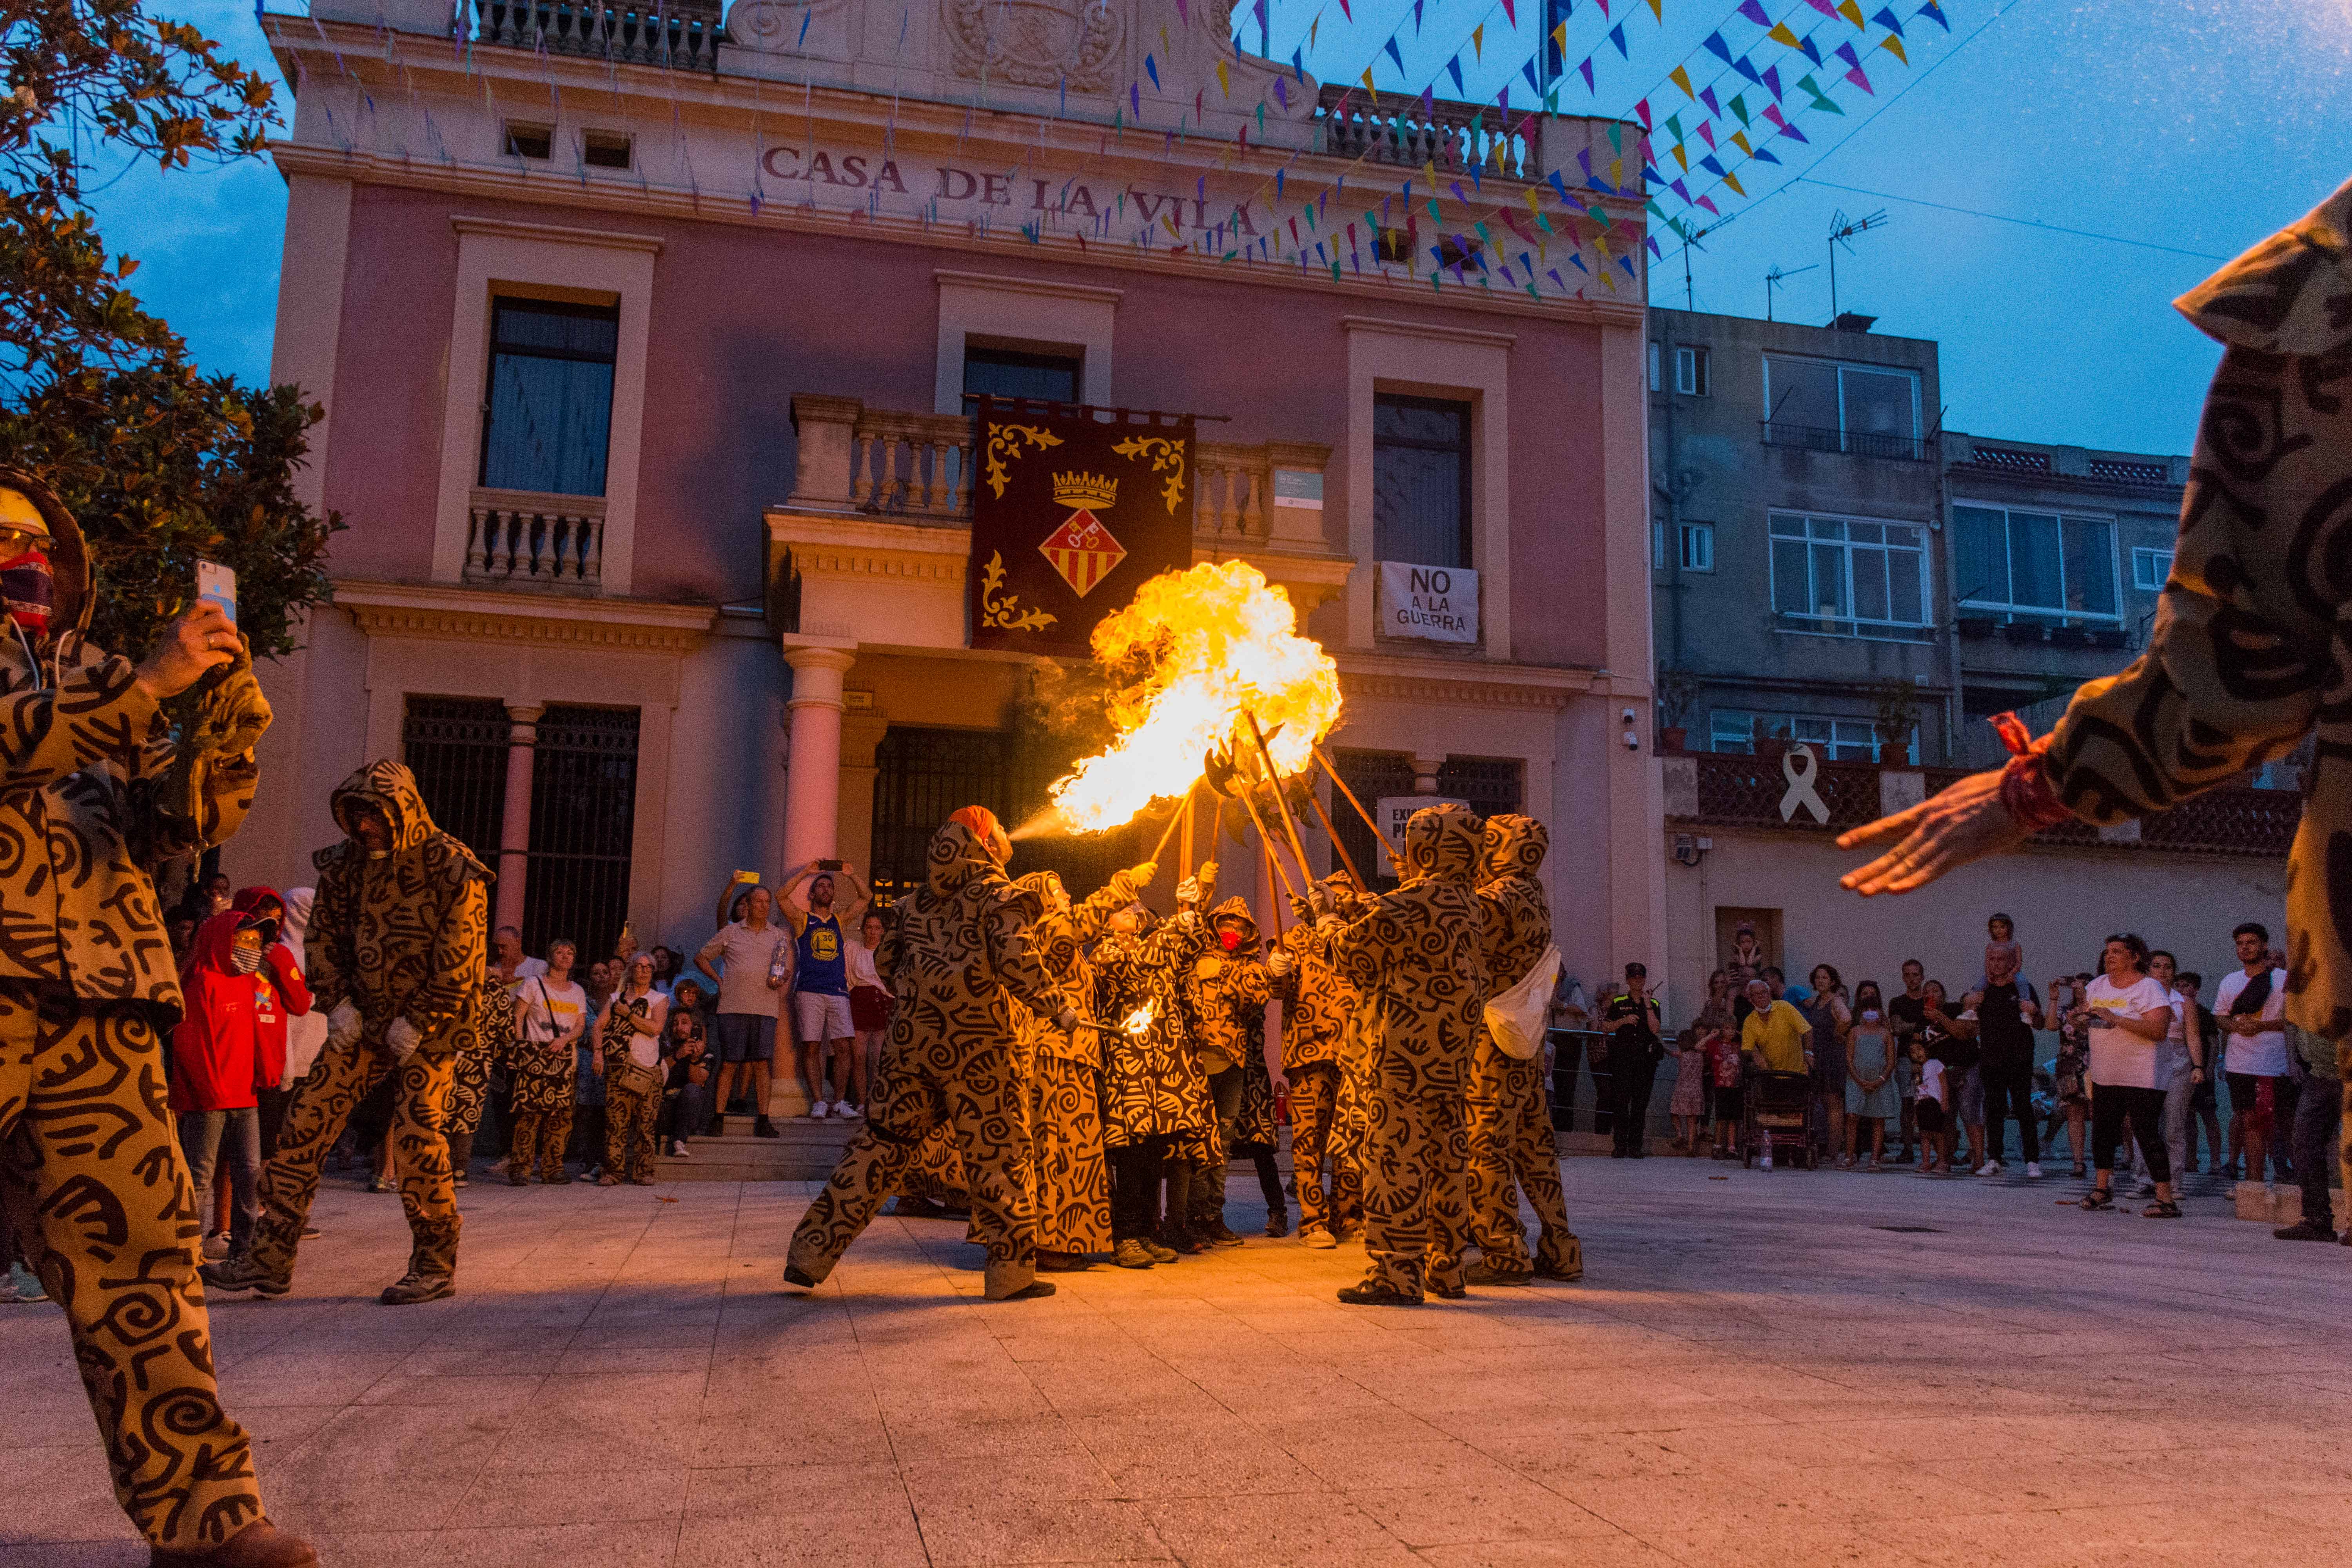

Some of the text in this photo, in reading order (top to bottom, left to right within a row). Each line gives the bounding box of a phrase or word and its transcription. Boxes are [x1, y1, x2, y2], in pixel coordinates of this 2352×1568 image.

[762, 146, 1259, 235] CASA DE LA VILA
[1411, 568, 1450, 594] NO
[1412, 596, 1449, 612] A LA
[1397, 610, 1466, 631] GUERRA
